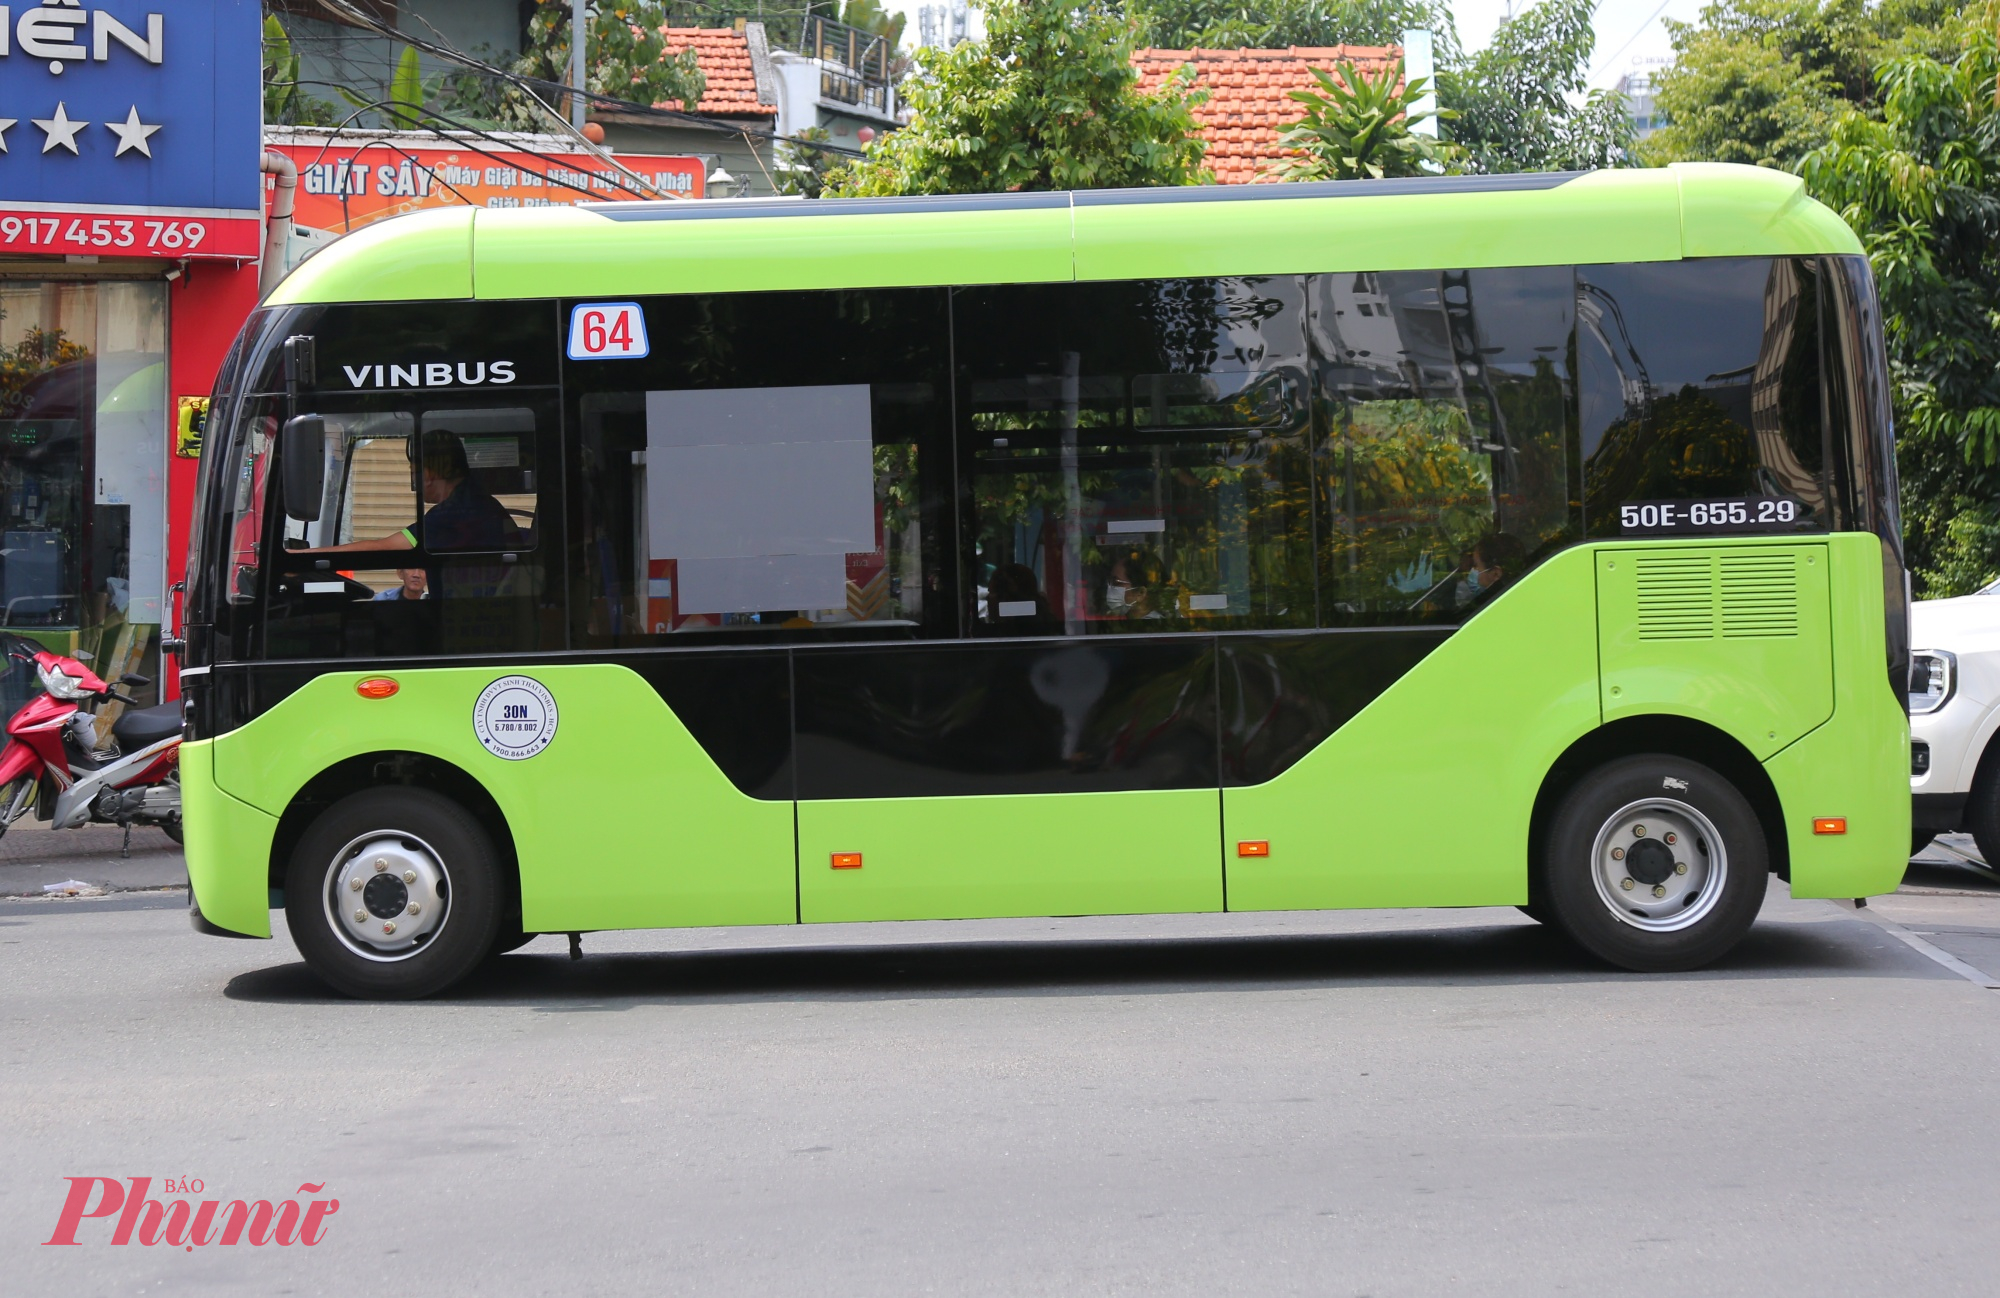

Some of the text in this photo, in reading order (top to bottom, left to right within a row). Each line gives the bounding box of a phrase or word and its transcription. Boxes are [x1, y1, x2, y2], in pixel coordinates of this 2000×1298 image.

[304, 155, 435, 201] GIẶT SẤY
[445, 165, 481, 188] Máy
[485, 167, 517, 190] Giặt
[547, 168, 588, 190] Năng
[655, 171, 693, 191] Nhật
[144, 221, 206, 249] 769
[583, 310, 634, 353] 64
[342, 360, 516, 388] VINBUS
[1620, 500, 1795, 528] 50E-655.29
[502, 679, 520, 688] SINH
[503, 705, 528, 719] 30N
[494, 723, 538, 732] 5.780/8.002
[492, 744, 540, 758] 1900.866.663
